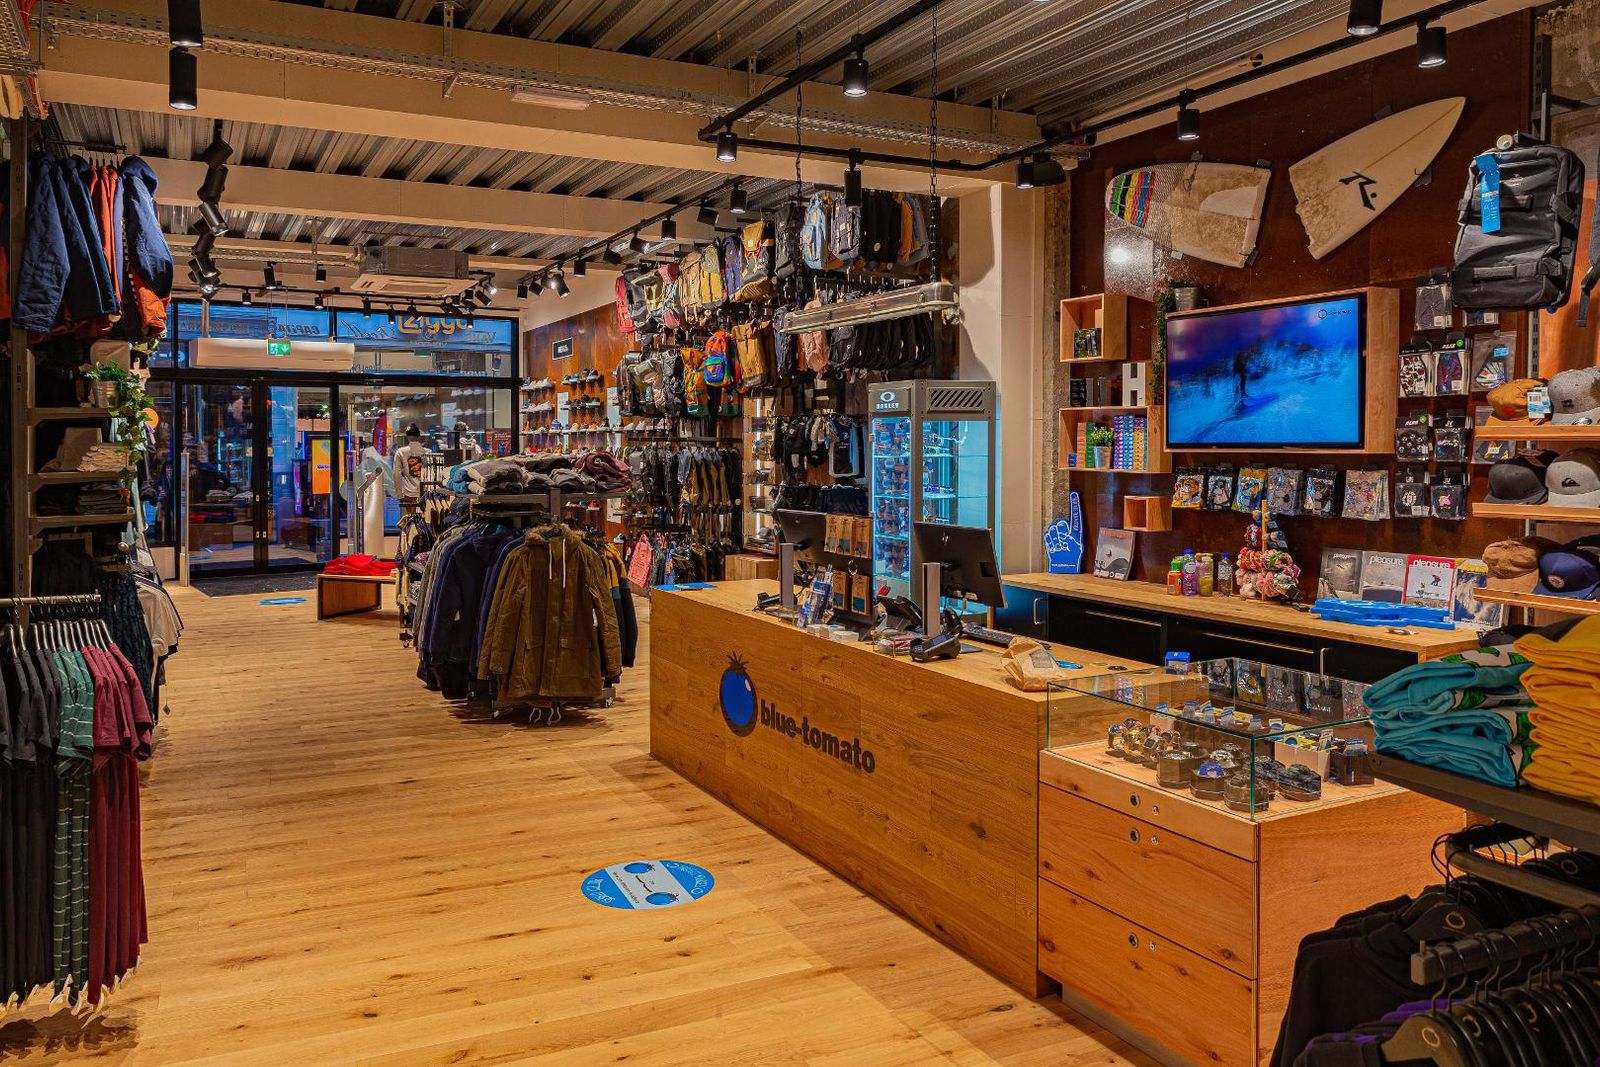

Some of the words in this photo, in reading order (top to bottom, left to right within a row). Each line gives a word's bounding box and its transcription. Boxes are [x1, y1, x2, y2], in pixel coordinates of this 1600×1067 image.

[1369, 554, 1404, 566] pleasure
[1412, 559, 1450, 569] pleasure
[760, 698, 876, 774] blue-tomato
